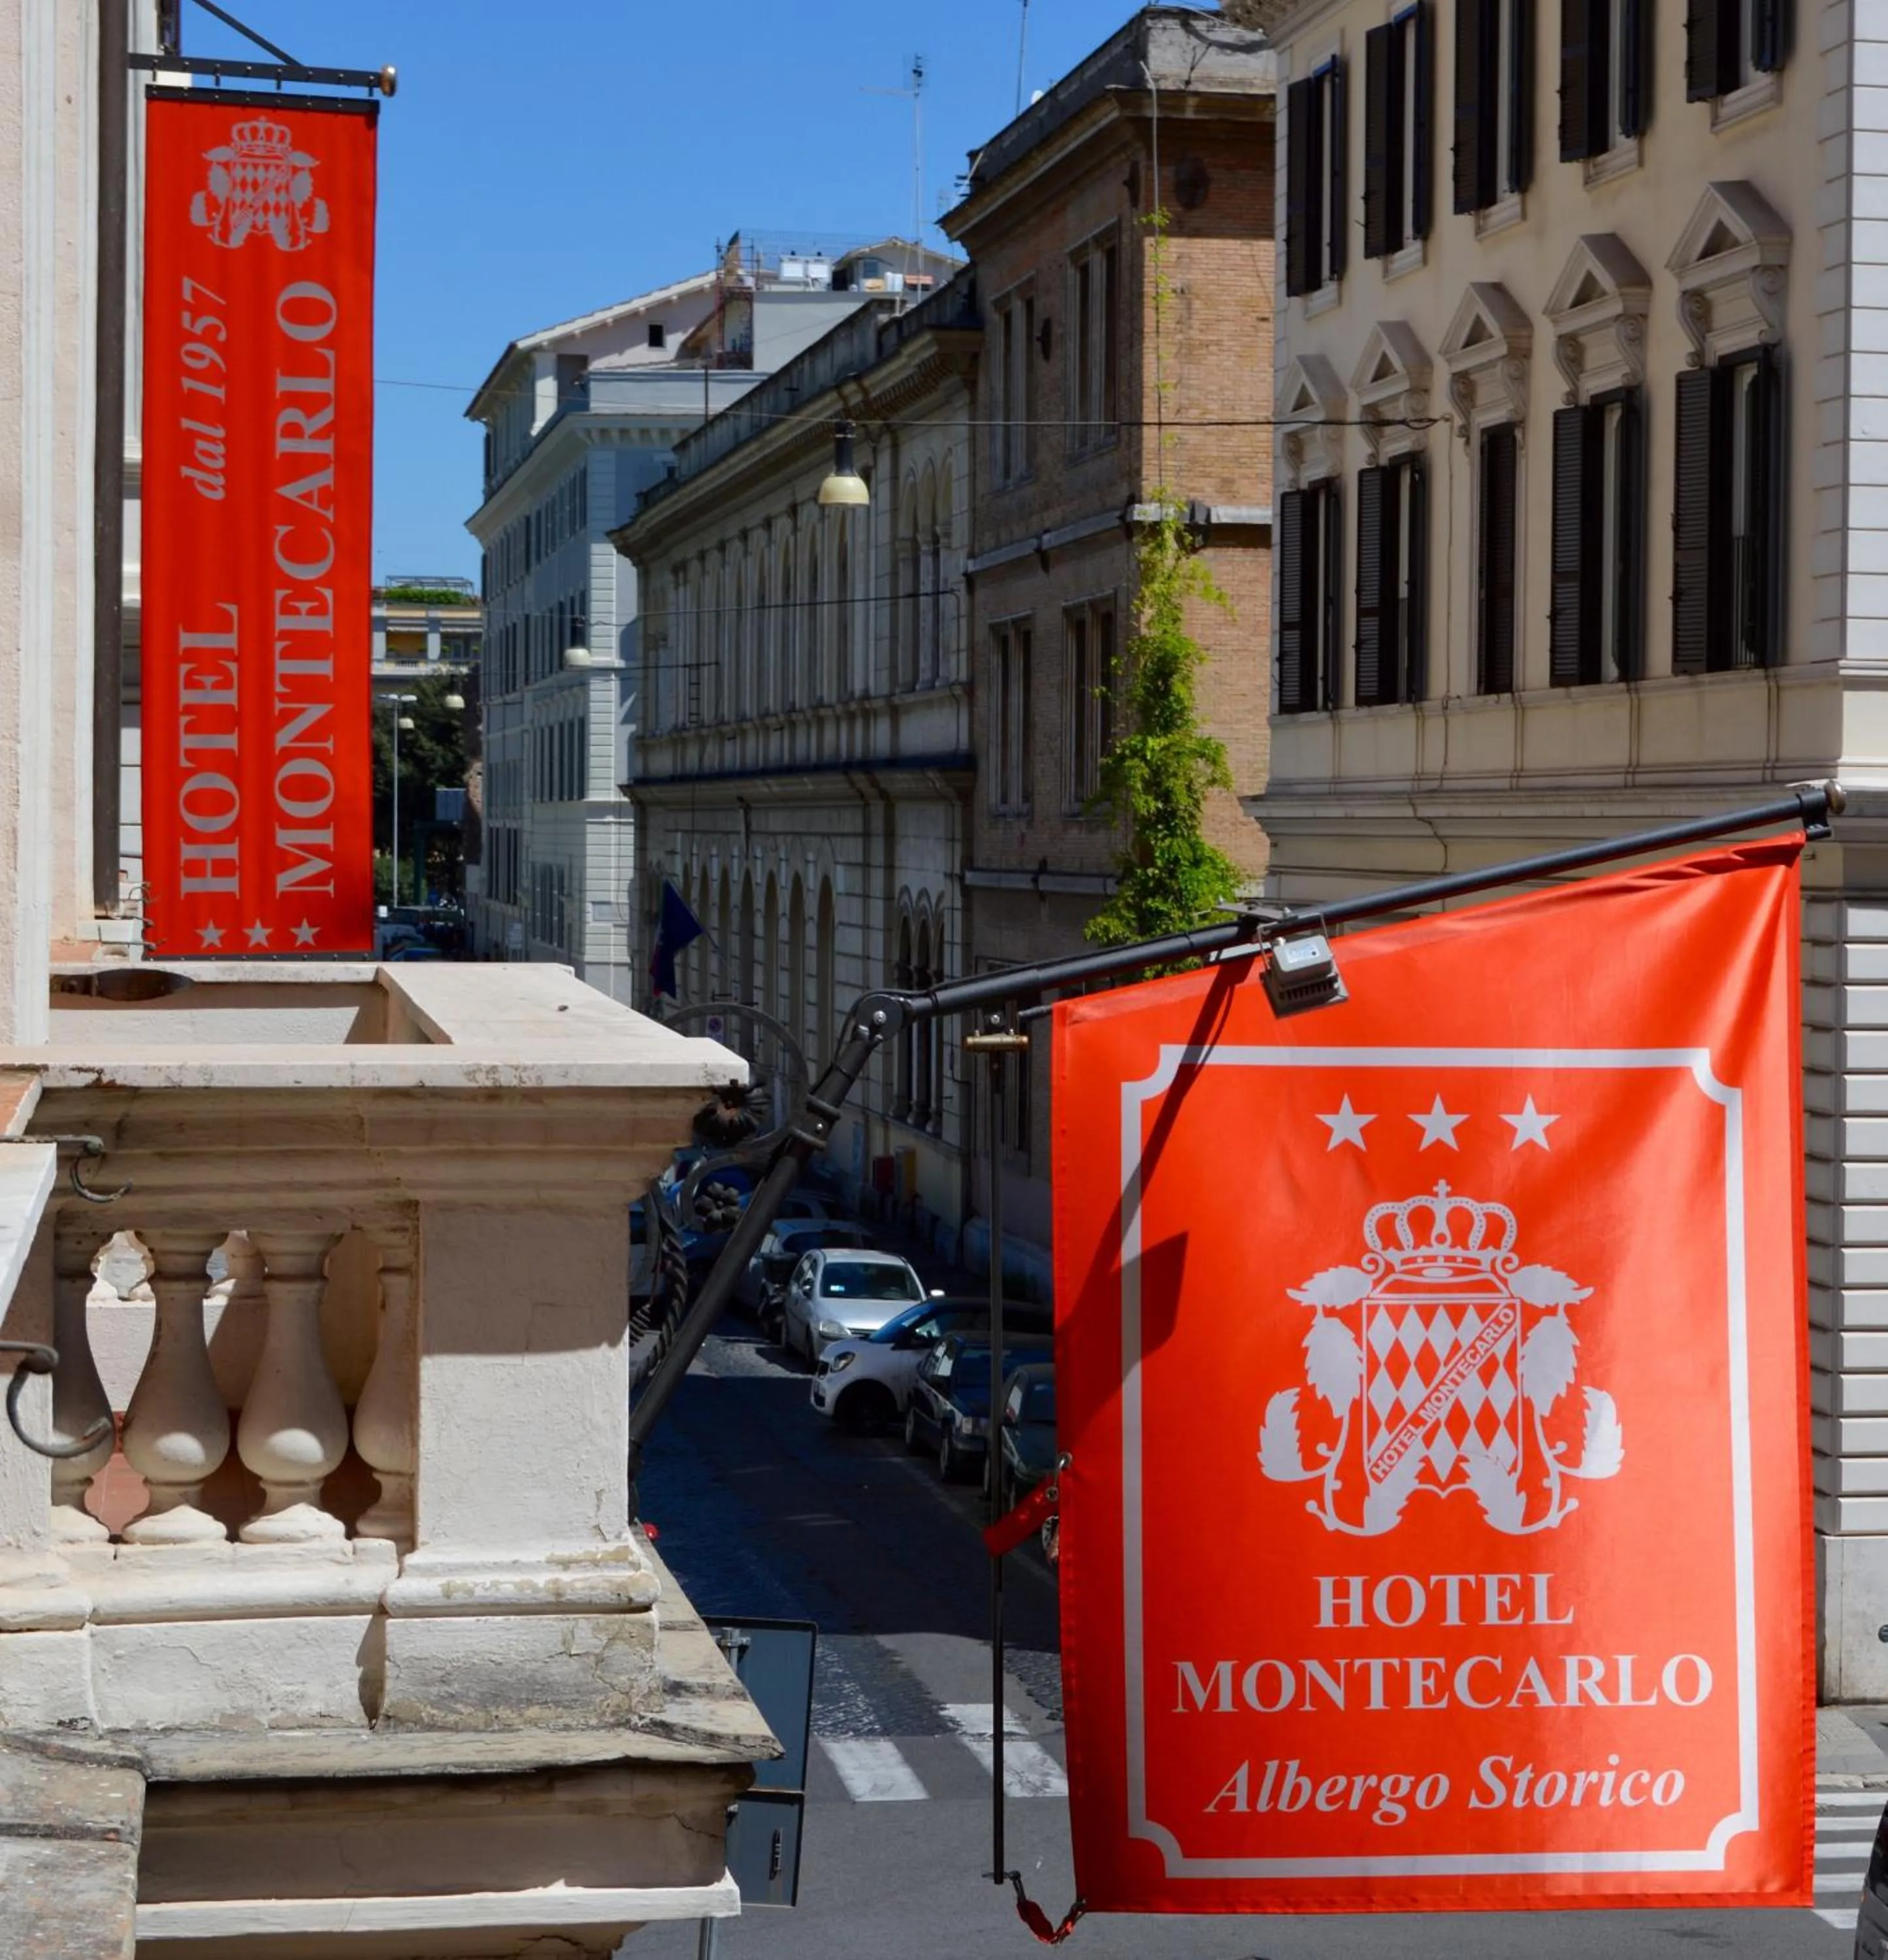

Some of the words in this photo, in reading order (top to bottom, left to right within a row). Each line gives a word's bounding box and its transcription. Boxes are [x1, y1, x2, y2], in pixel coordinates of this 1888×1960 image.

[180, 276, 227, 405] 1957
[180, 413, 227, 500] dal
[274, 280, 337, 899] MONTECARLO
[179, 602, 240, 899] HOTEL
[1371, 1423, 1423, 1479] HOTEL
[1419, 1307, 1515, 1421] MONTECARLO
[1314, 1573, 1574, 1628] HOTEL
[1171, 1653, 1714, 1713] MONTECARLO
[1204, 1759, 1450, 1827] Albergo
[1468, 1753, 1687, 1810] Storico
